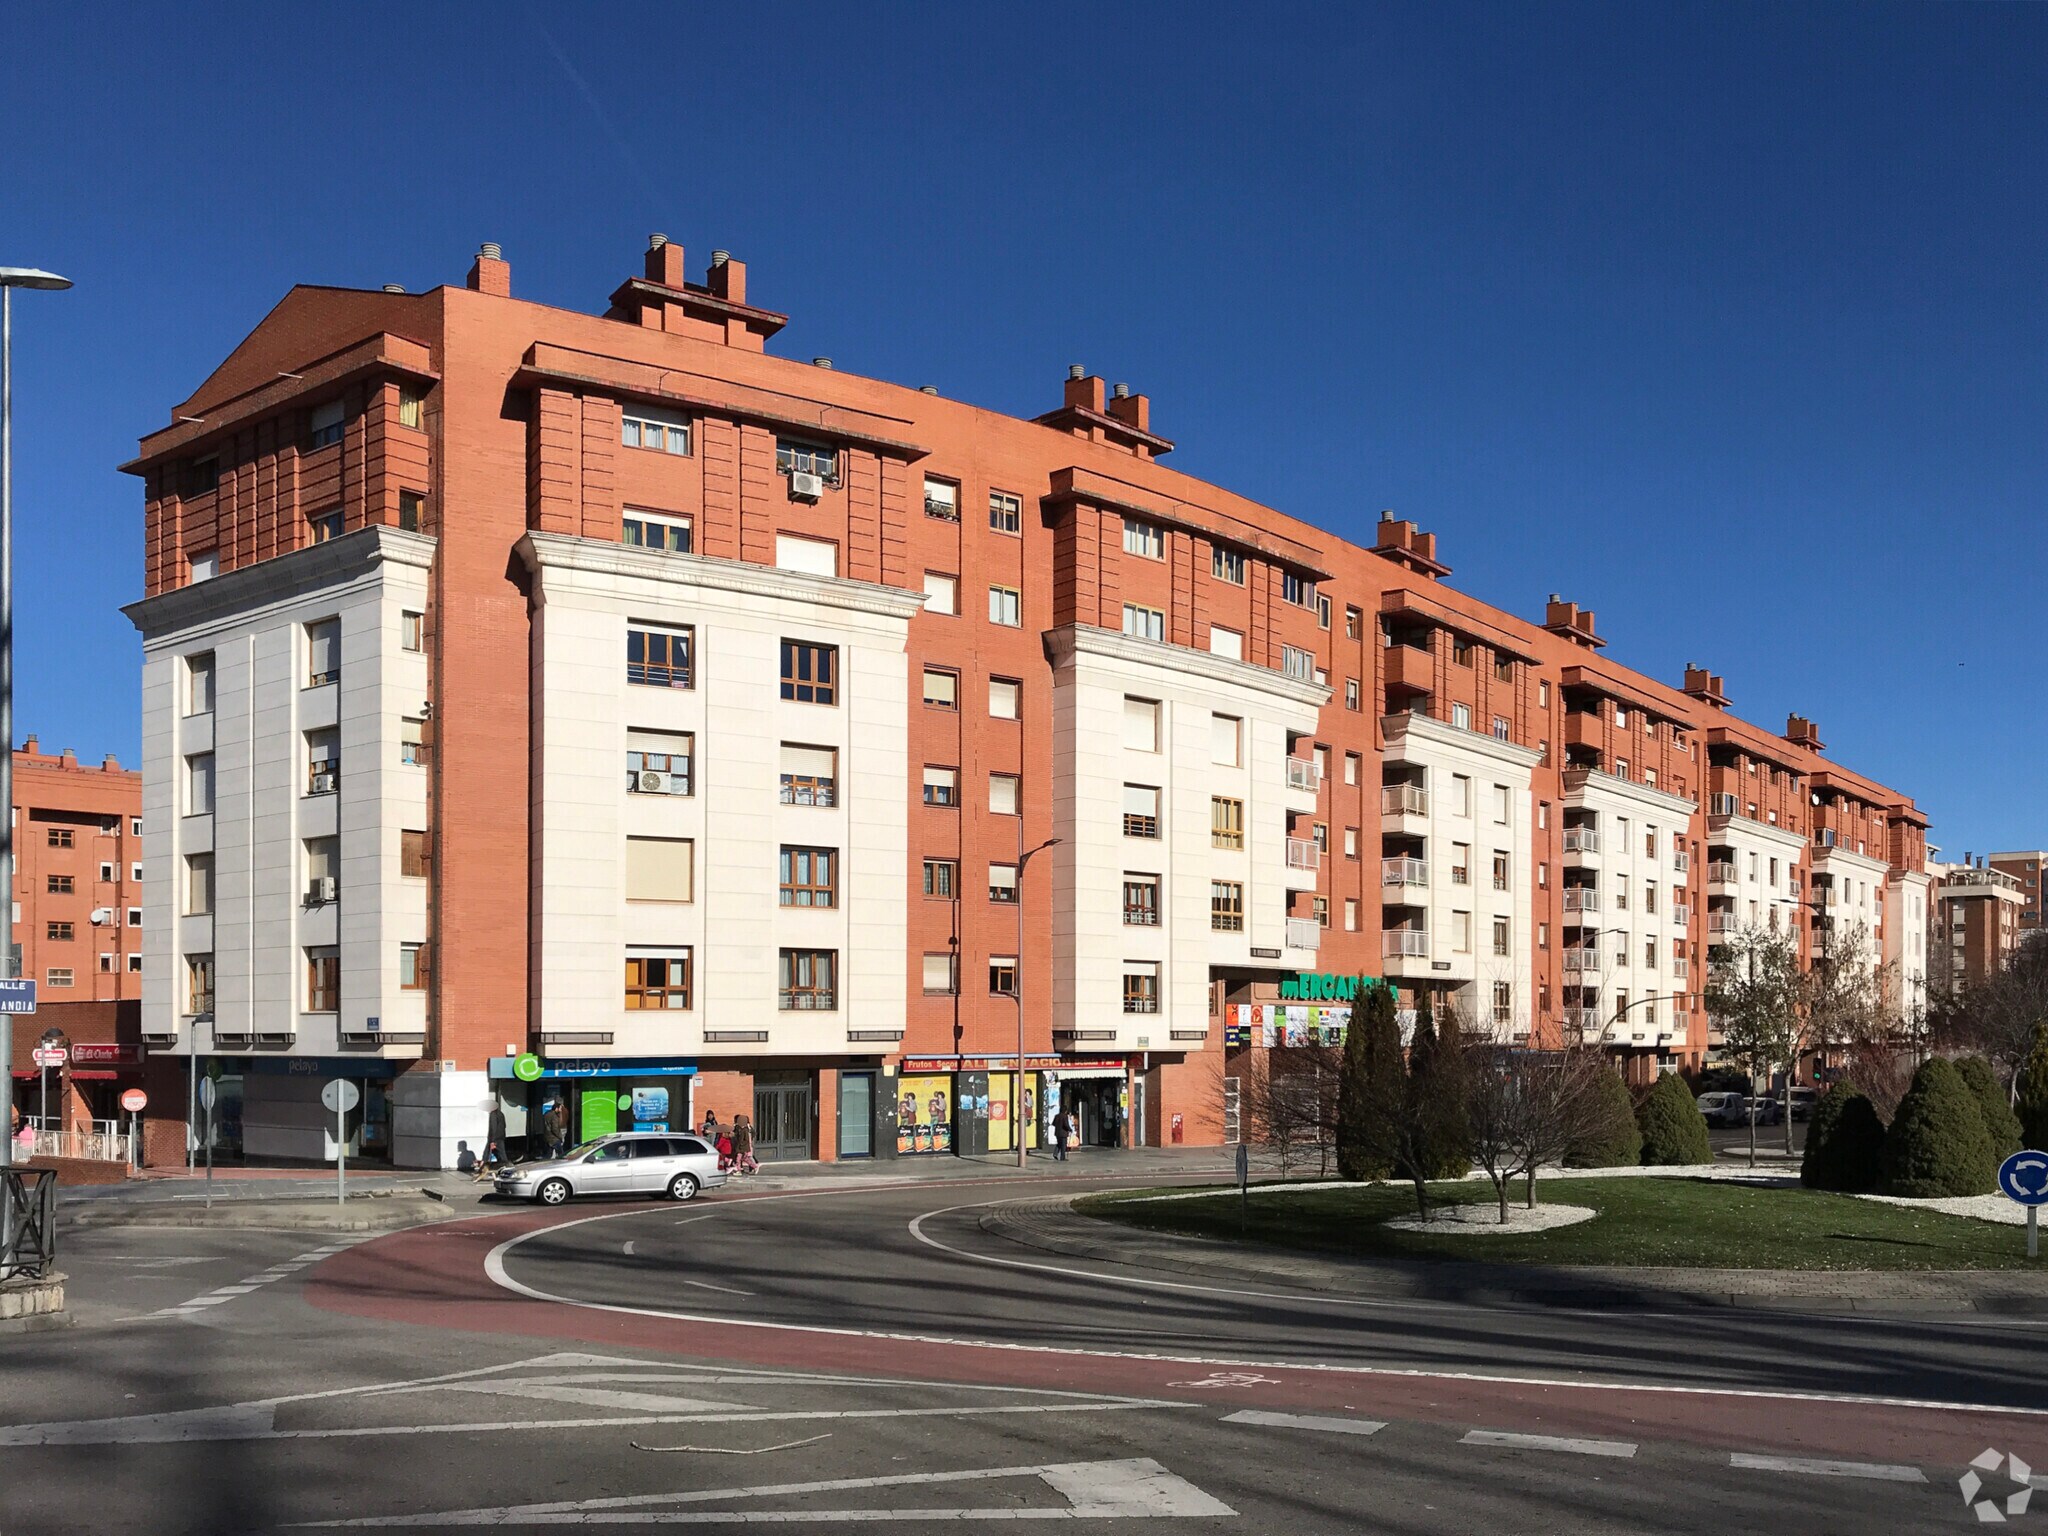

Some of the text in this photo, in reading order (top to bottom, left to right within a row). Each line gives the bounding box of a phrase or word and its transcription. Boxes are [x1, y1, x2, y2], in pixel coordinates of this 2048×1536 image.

[288, 1058, 318, 1075] pelayo
[555, 1059, 611, 1077] pelayo
[908, 1060, 932, 1068] Frutos
